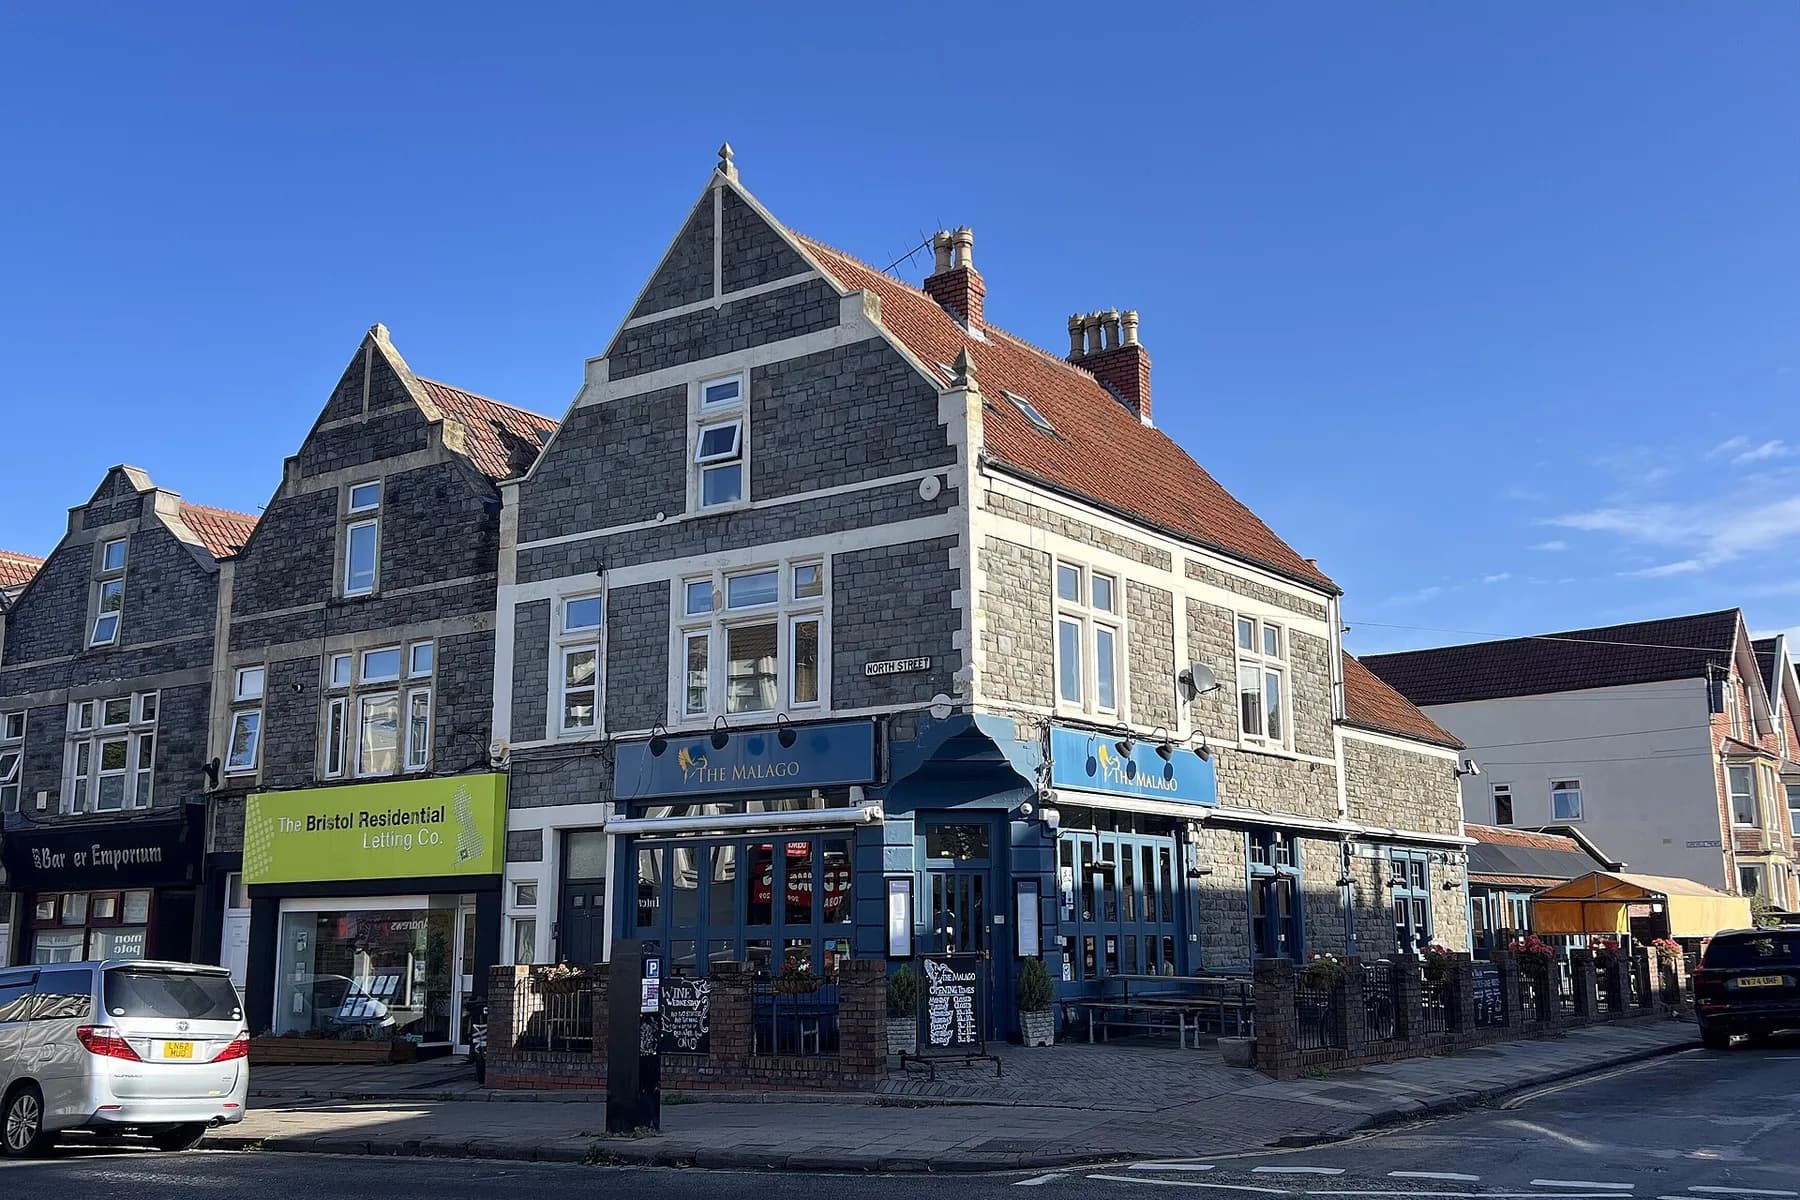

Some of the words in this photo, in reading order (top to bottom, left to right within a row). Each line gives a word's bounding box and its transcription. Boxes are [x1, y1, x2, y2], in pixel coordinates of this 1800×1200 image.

[867, 662, 895, 674] NORTH
[897, 657, 928, 671] STREET
[697, 767, 726, 783] THE
[732, 761, 800, 780] MALAGO
[278, 816, 301, 833] The
[306, 812, 353, 831] Bristol
[358, 805, 445, 828] Residential
[363, 829, 412, 850] Letting
[417, 828, 443, 846] Co.
[92, 843, 161, 871] Emporium
[650, 962, 657, 975] P
[661, 986, 692, 999] WINE
